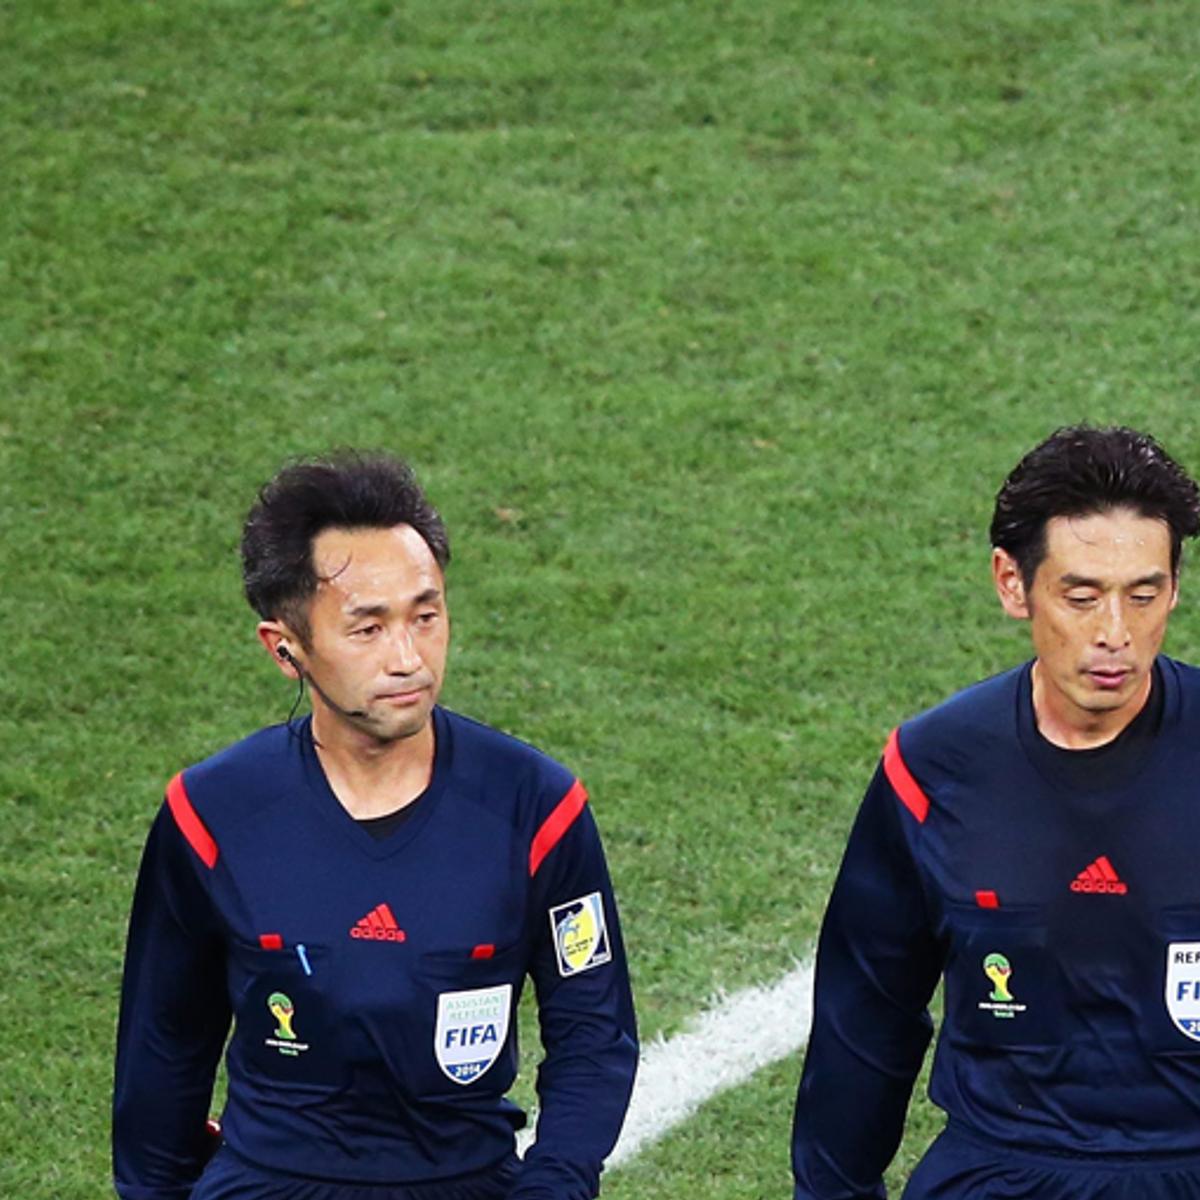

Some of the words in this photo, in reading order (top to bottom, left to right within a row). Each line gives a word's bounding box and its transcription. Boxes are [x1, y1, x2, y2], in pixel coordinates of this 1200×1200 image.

[1070, 879, 1127, 895] adidas
[350, 925, 406, 942] adidas
[447, 993, 506, 1010] ASSISTANT
[450, 1007, 498, 1020] REFEREE
[445, 1023, 497, 1049] FIFA
[455, 1063, 481, 1077] 2014
